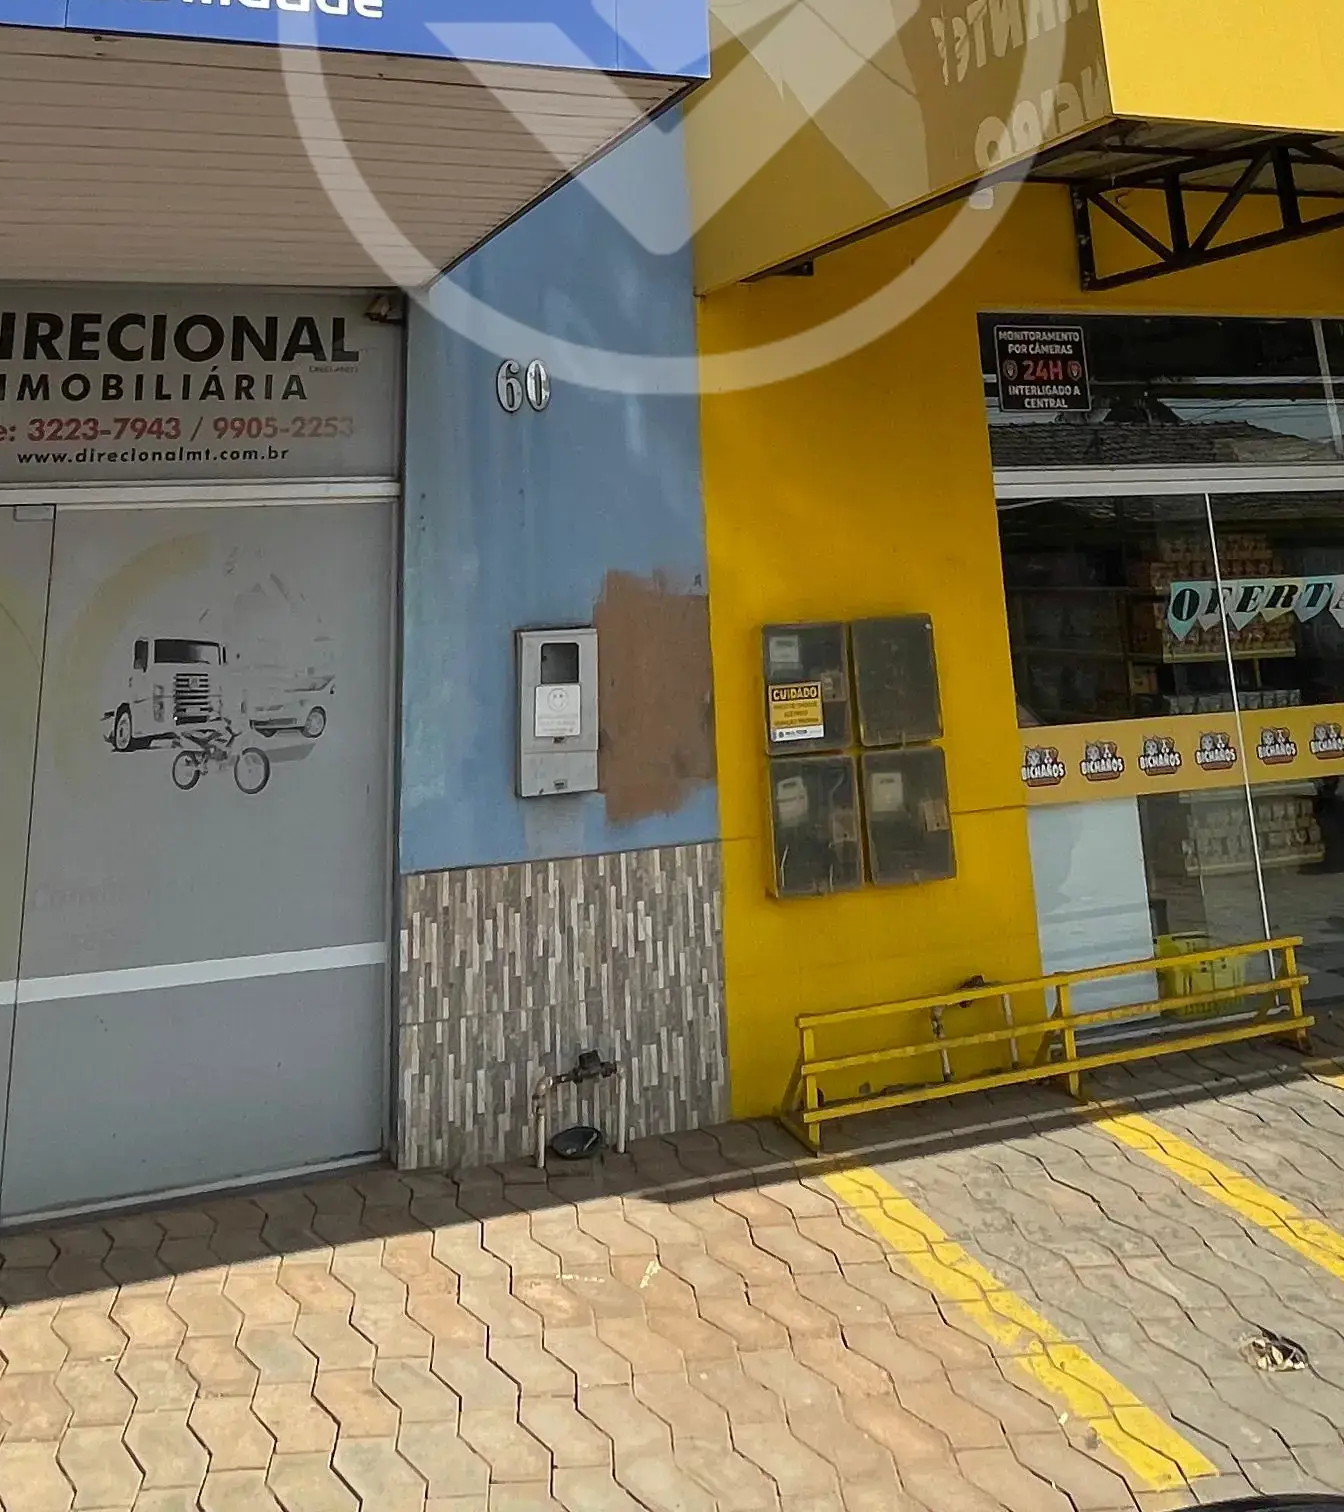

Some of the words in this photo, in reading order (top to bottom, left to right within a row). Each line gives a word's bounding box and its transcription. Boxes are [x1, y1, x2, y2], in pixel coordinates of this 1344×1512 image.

[998, 331, 1080, 342] MONITORAMENTO
[1007, 344, 1027, 354] POR
[1028, 341, 1073, 355] CÂMERAS
[1022, 360, 1064, 381] 24H
[495, 359, 552, 414] 60
[1008, 385, 1072, 396] INTERLIGADO
[1073, 386, 1081, 396] A
[1024, 398, 1068, 408] CENTRAL
[27, 417, 182, 443] 3223-7943
[188, 416, 203, 443] /
[212, 416, 355, 440] 9905-2253
[17, 445, 290, 467] www.direcionalmt.com.br
[773, 686, 818, 701] CUIDADO
